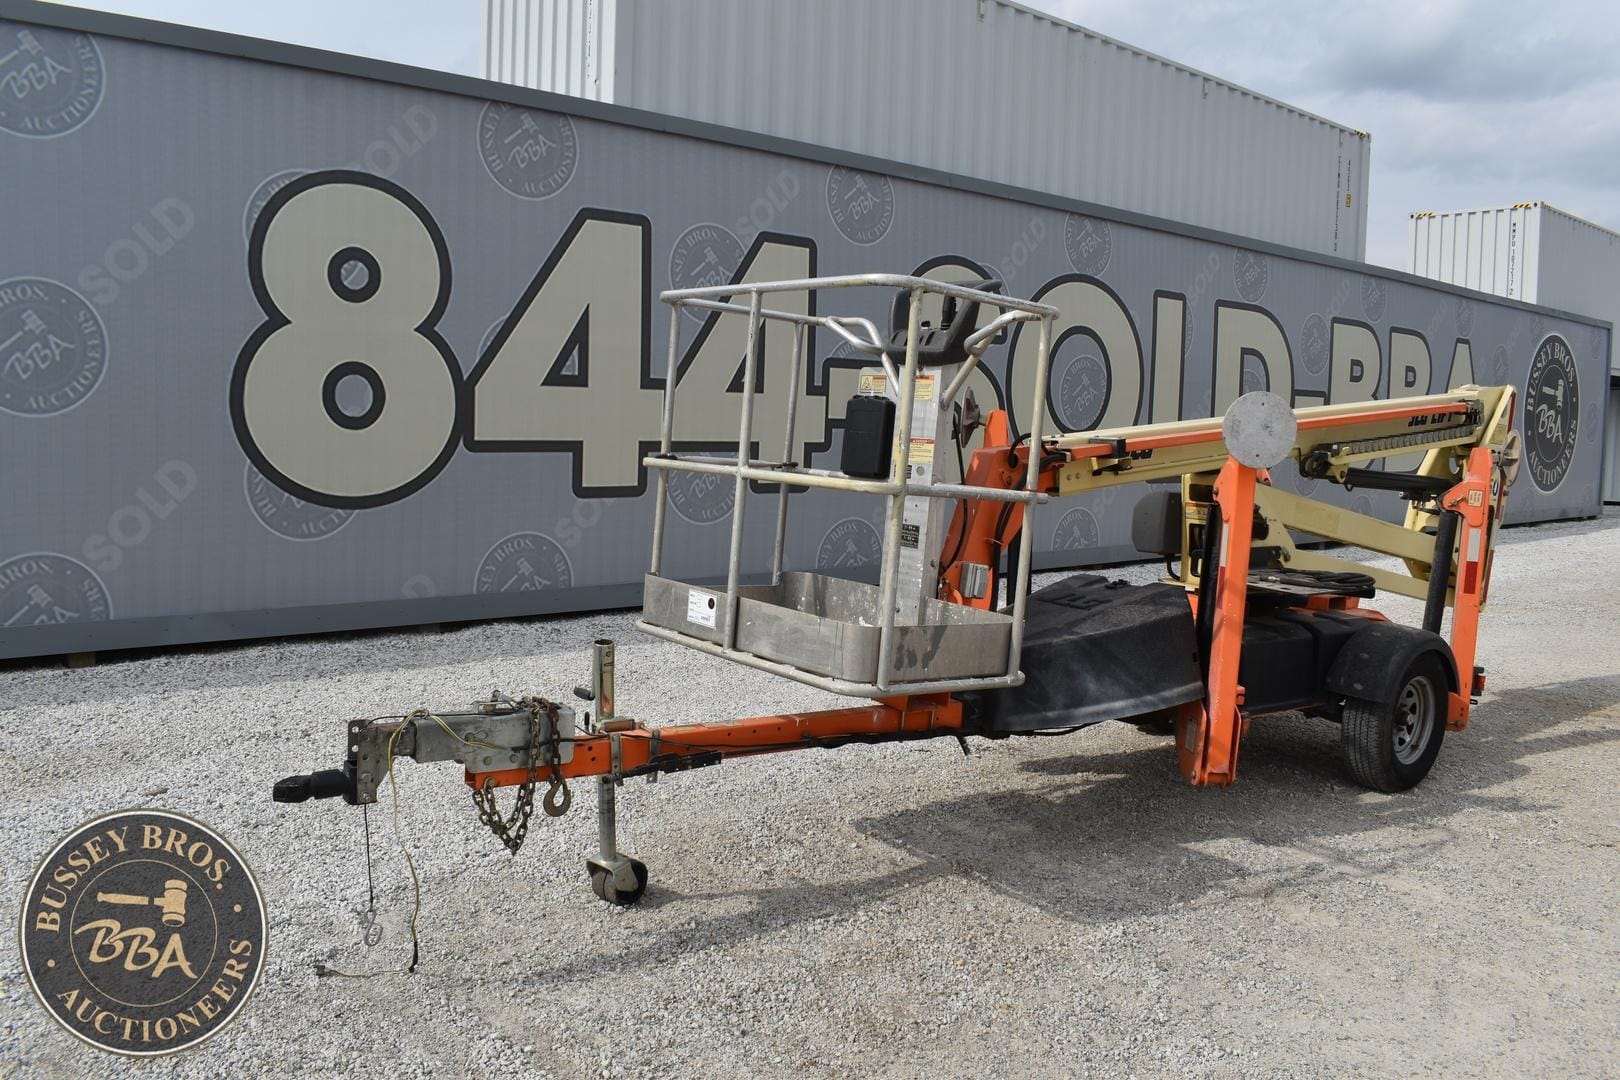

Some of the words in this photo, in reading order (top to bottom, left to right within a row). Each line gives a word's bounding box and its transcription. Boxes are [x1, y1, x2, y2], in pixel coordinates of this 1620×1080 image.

[77, 197, 195, 305] SOLD
[1527, 343, 1554, 412] BUSSEY
[1529, 419, 1577, 486] AUCTIONEERS
[1535, 403, 1564, 444] BBA
[82, 458, 198, 572] SOLD
